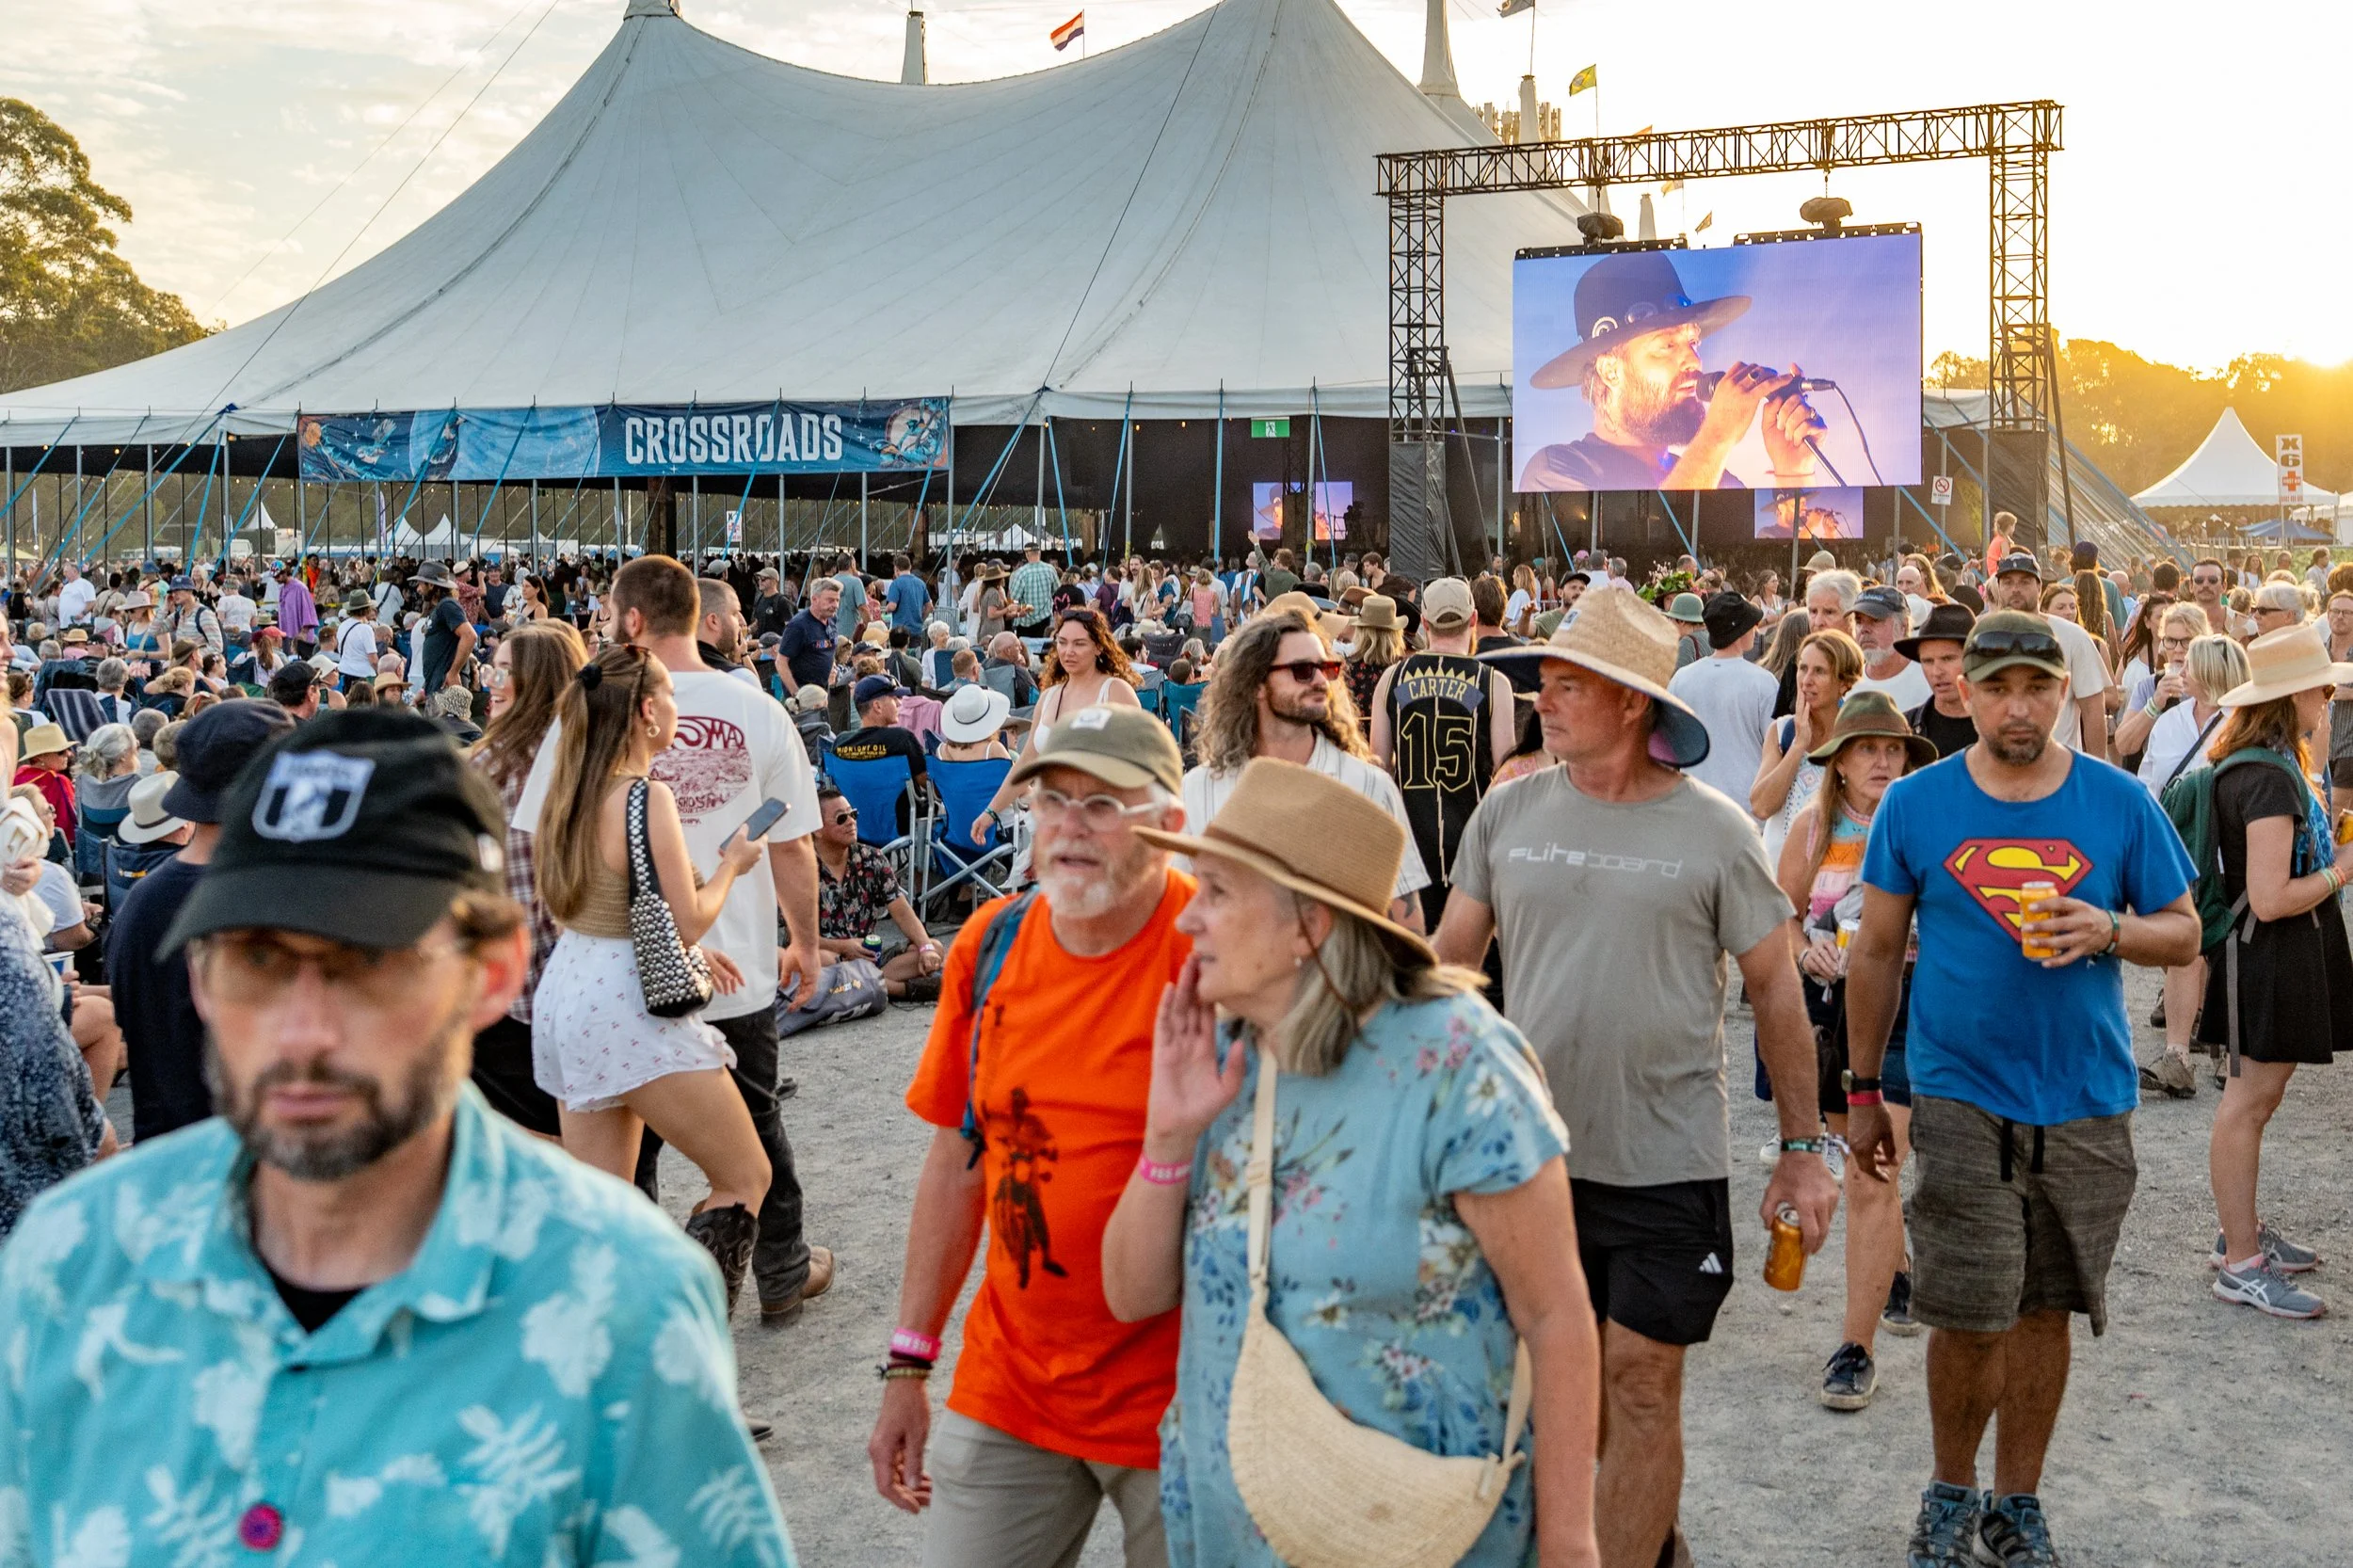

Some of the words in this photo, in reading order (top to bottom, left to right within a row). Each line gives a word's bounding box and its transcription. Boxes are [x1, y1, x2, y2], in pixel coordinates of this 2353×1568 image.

[625, 413, 842, 464] CROSSROADS
[2281, 438, 2299, 450] X
[2281, 454, 2300, 467] 6
[1408, 677, 1467, 701] CARTER
[872, 744, 887, 752] OIL
[1401, 712, 1473, 792] 15
